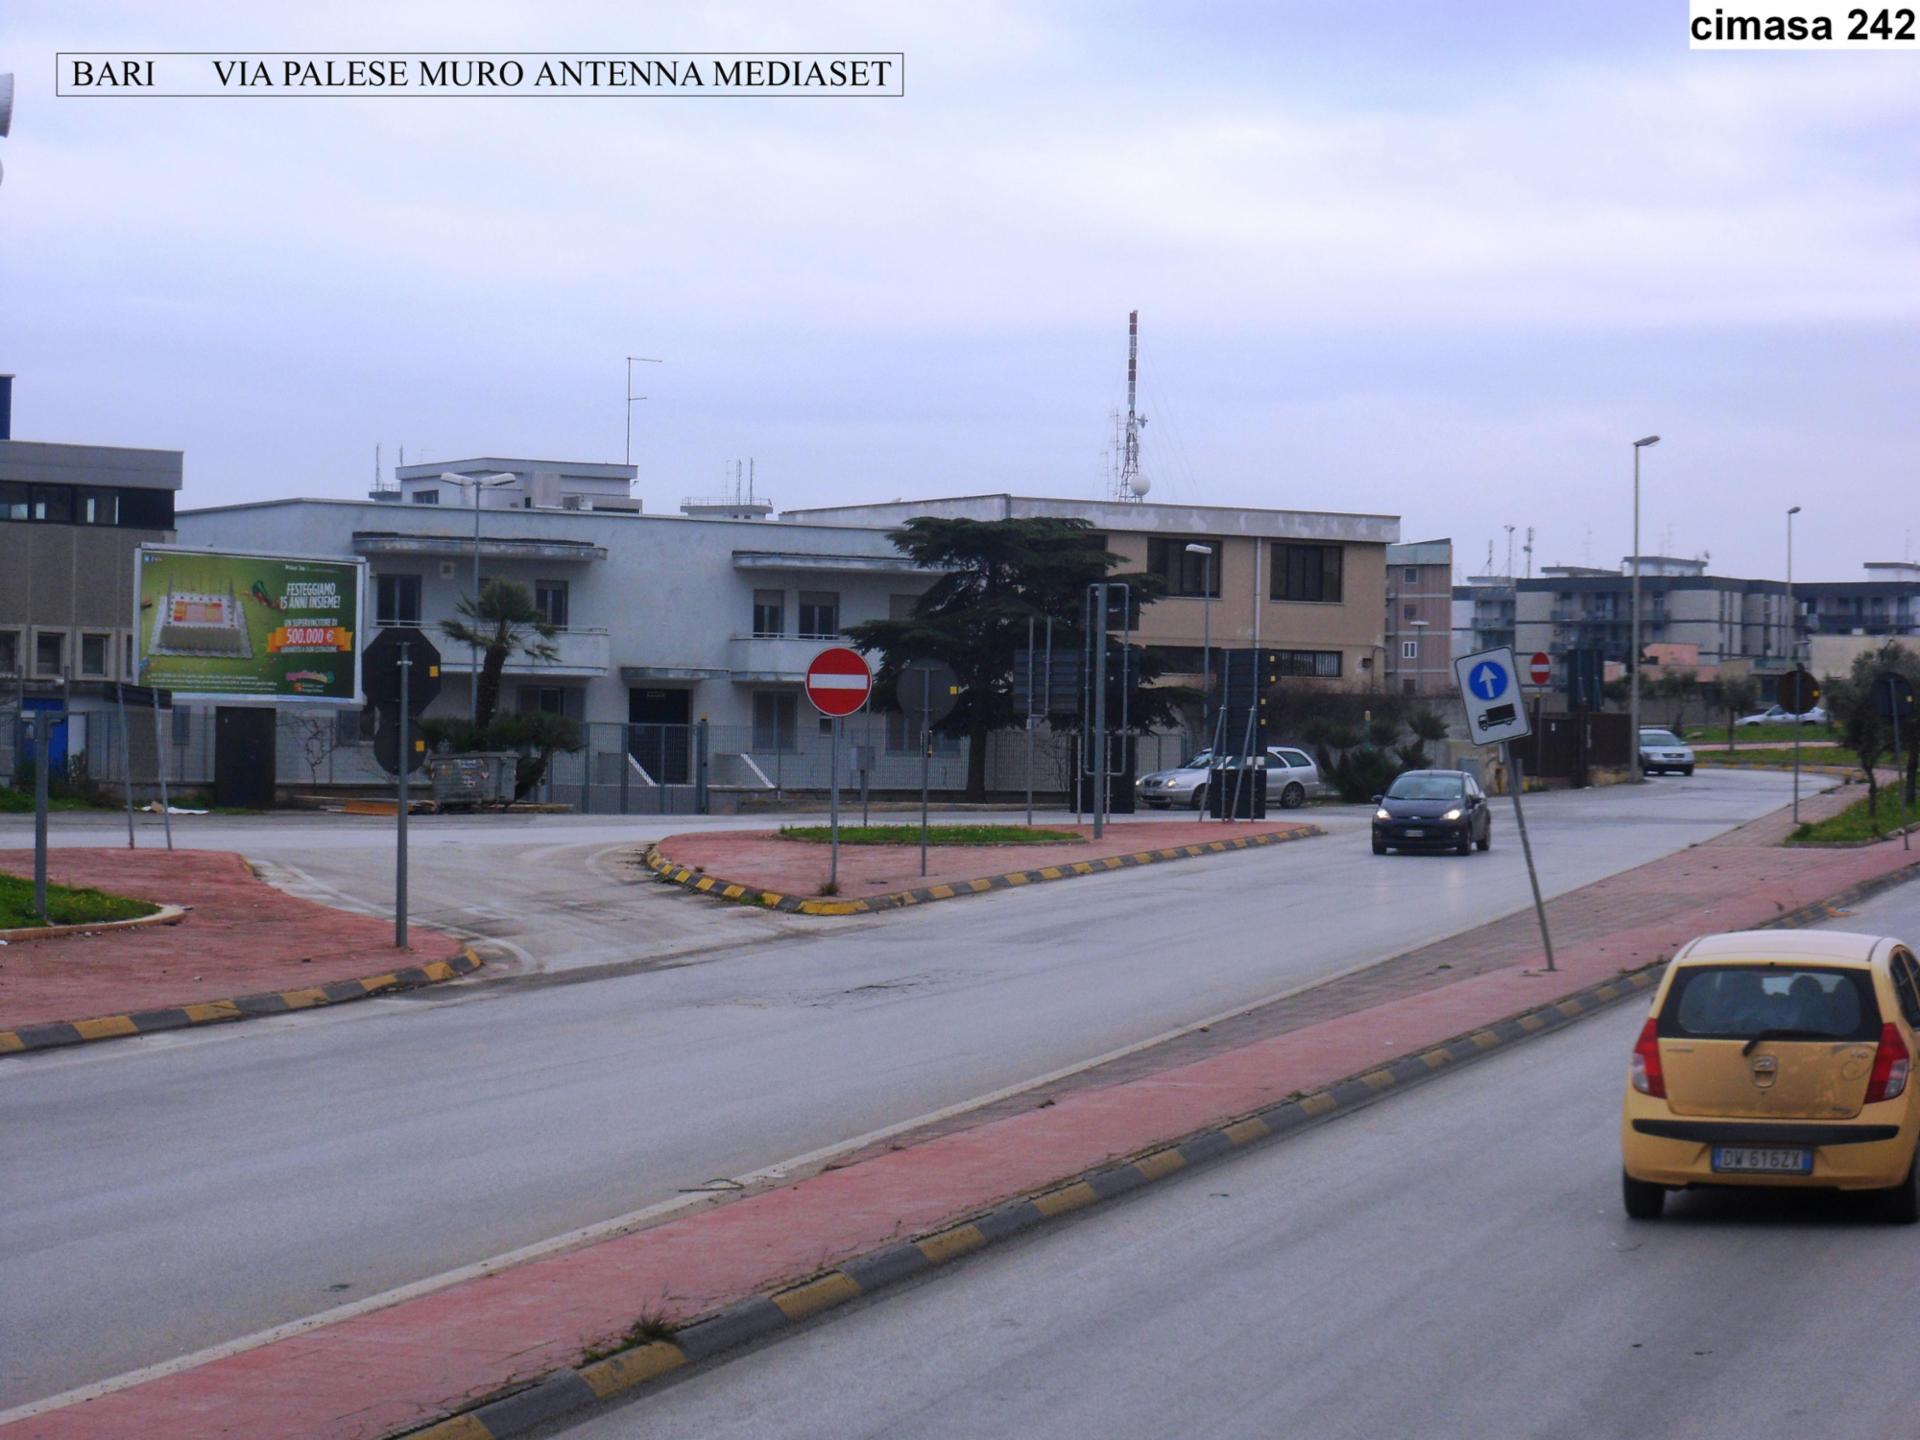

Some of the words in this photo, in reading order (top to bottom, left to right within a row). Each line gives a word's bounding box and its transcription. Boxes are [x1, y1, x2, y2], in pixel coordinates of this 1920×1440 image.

[286, 583, 336, 596] FESTEGGIAMO
[279, 596, 288, 609] 15
[288, 596, 309, 608] ANNI
[287, 628, 324, 643] 500.000
[326, 630, 335, 643] €
[1723, 1150, 1744, 1166] DW
